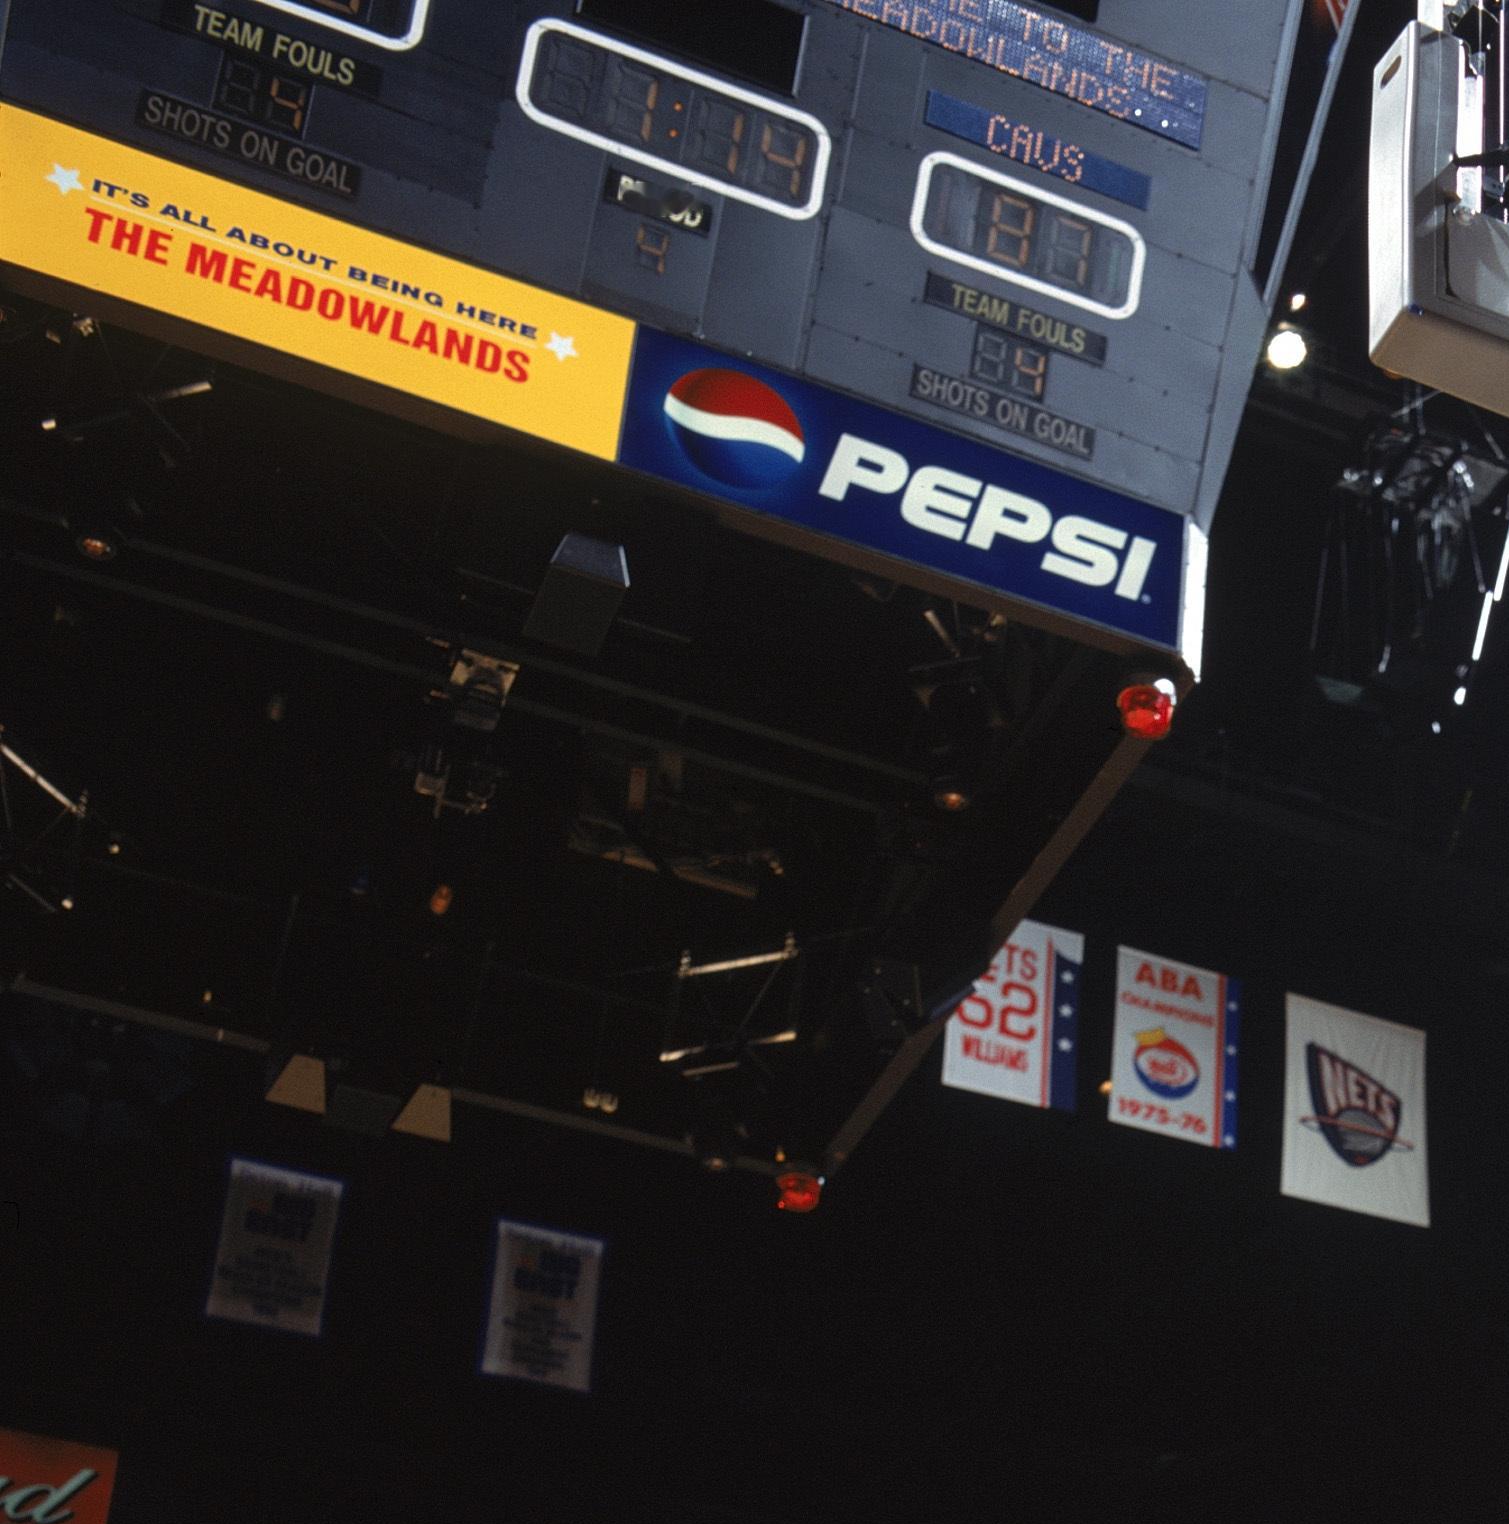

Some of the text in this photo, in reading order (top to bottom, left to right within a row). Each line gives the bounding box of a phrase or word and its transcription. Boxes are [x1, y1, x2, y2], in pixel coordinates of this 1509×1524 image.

[194, 5, 356, 86] TEAM FOULS
[836, 0, 1131, 119] EADOWLANDS
[1018, 8, 1070, 52] TO
[1100, 40, 1178, 100] THE
[144, 96, 351, 192] SHOTS ON GOAL
[271, 77, 305, 131] 4
[986, 114, 1085, 182] CAVS
[91, 178, 539, 341] IT'S ALL ABOUT BEING HERE
[636, 223, 669, 275] 4
[987, 193, 1093, 288] 87
[84, 207, 532, 385] THE MEADOWLANDS
[951, 283, 1087, 354] TEAM FOULS
[916, 368, 1093, 451] SHOTS ON GOAL
[1014, 346, 1046, 397] 4
[818, 433, 1157, 601] PEPSI
[1135, 961, 1204, 1003] ABA
[1118, 1096, 1207, 1135] 1975-76
[1317, 1049, 1399, 1133] NETS
